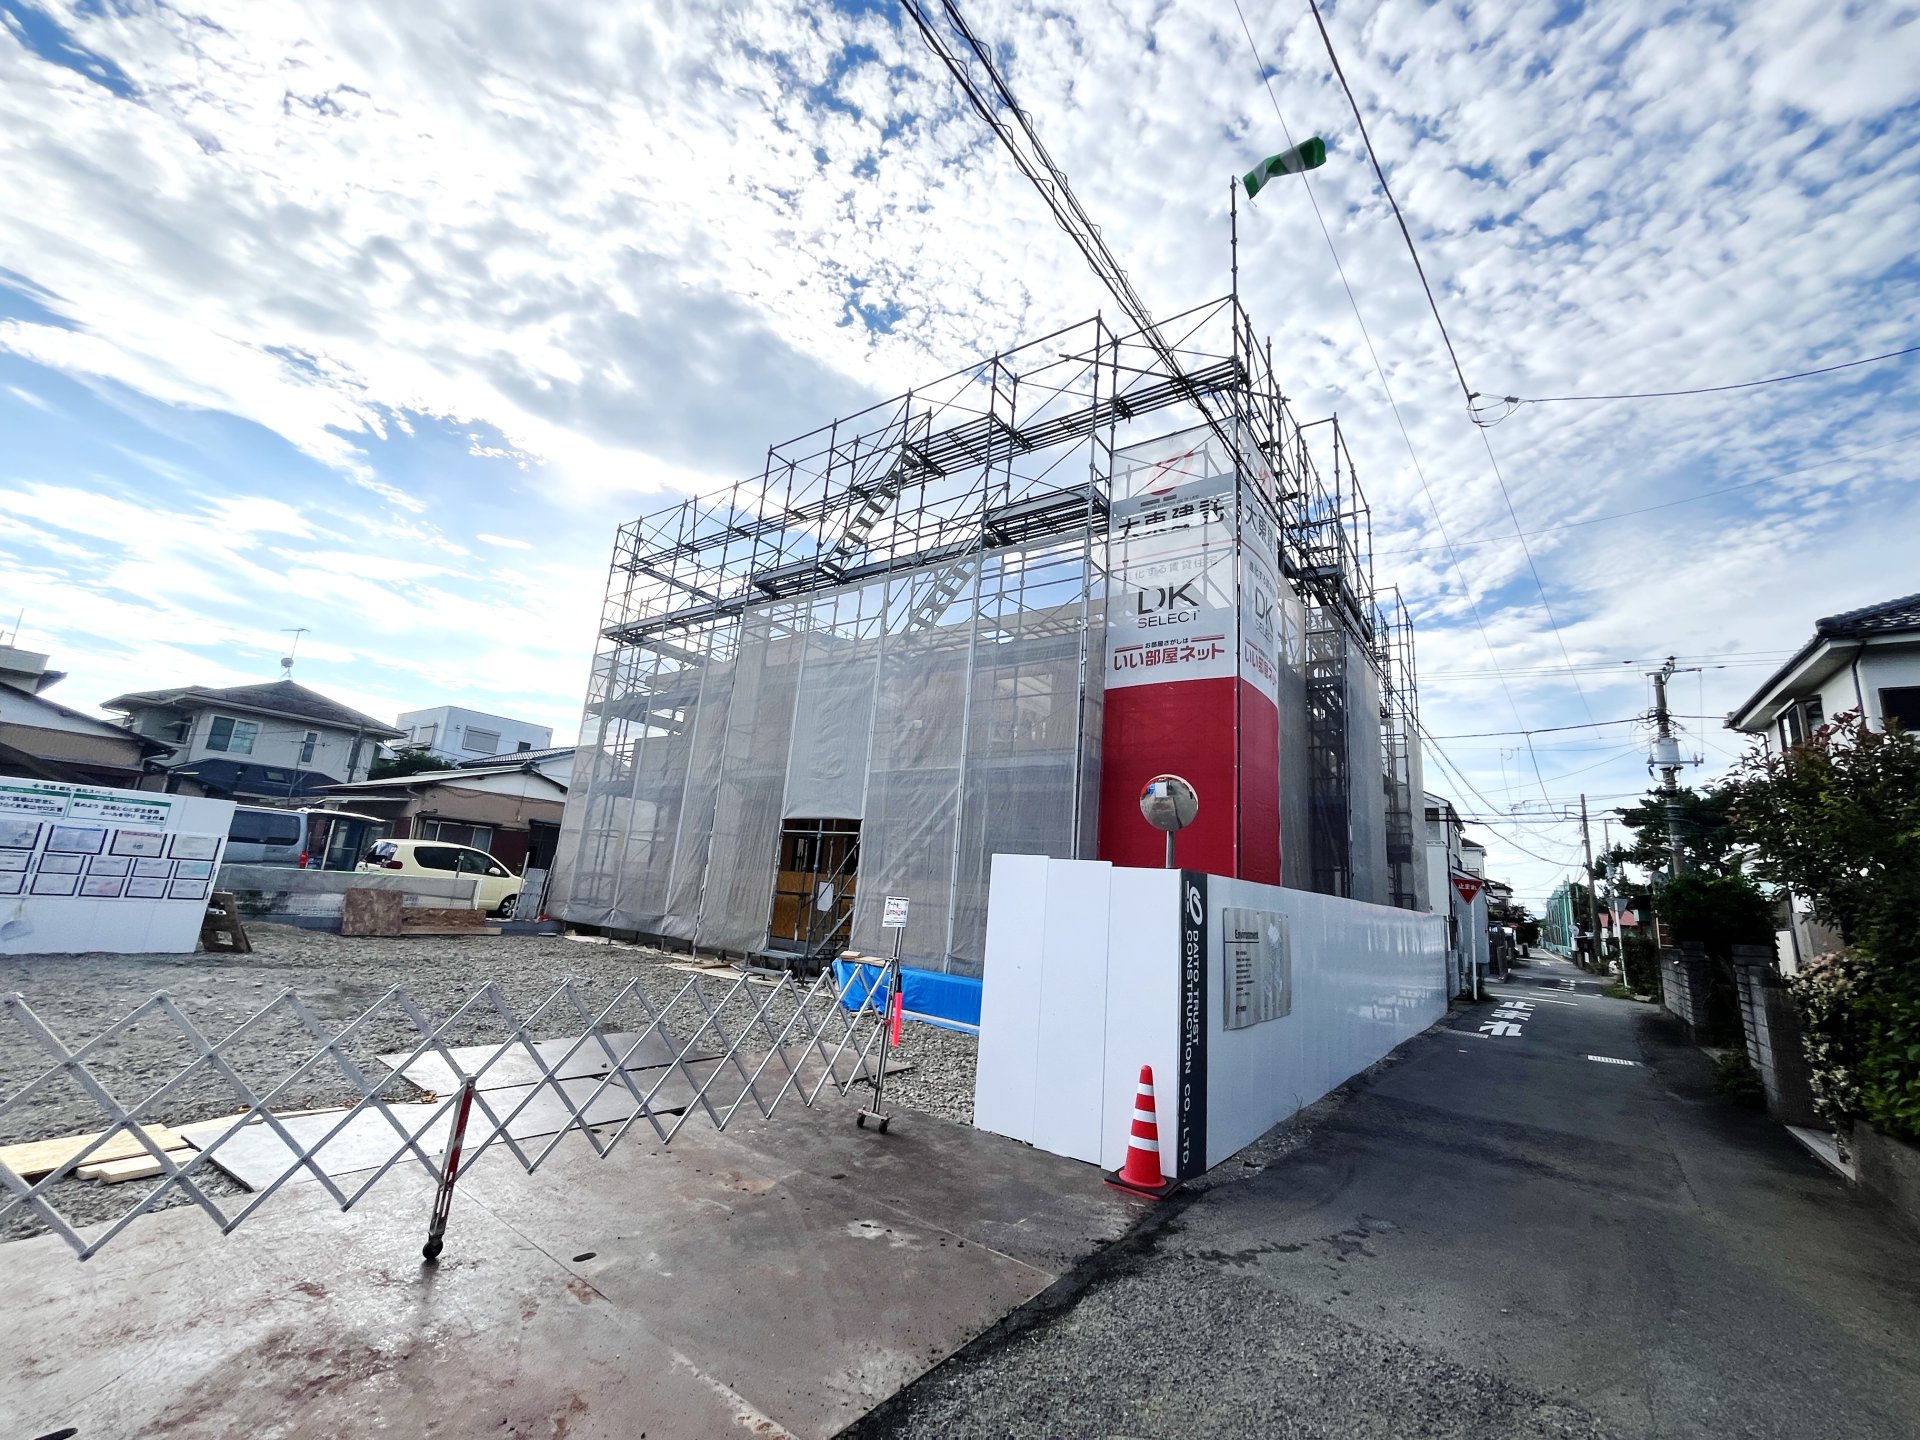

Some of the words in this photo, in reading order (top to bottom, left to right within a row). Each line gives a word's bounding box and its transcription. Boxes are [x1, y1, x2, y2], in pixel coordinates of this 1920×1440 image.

[1138, 583, 1199, 615] DK
[1255, 586, 1274, 633] DK
[1138, 610, 1198, 629] SELECT
[1114, 643, 1225, 670] いい部屋ネット
[1145, 638, 1189, 649] お部屋さがしは
[1185, 930, 1194, 1074] CONSTRUCTION
[1192, 987, 1200, 1046] TRUST
[1478, 1001, 1537, 1037] 止まれ
